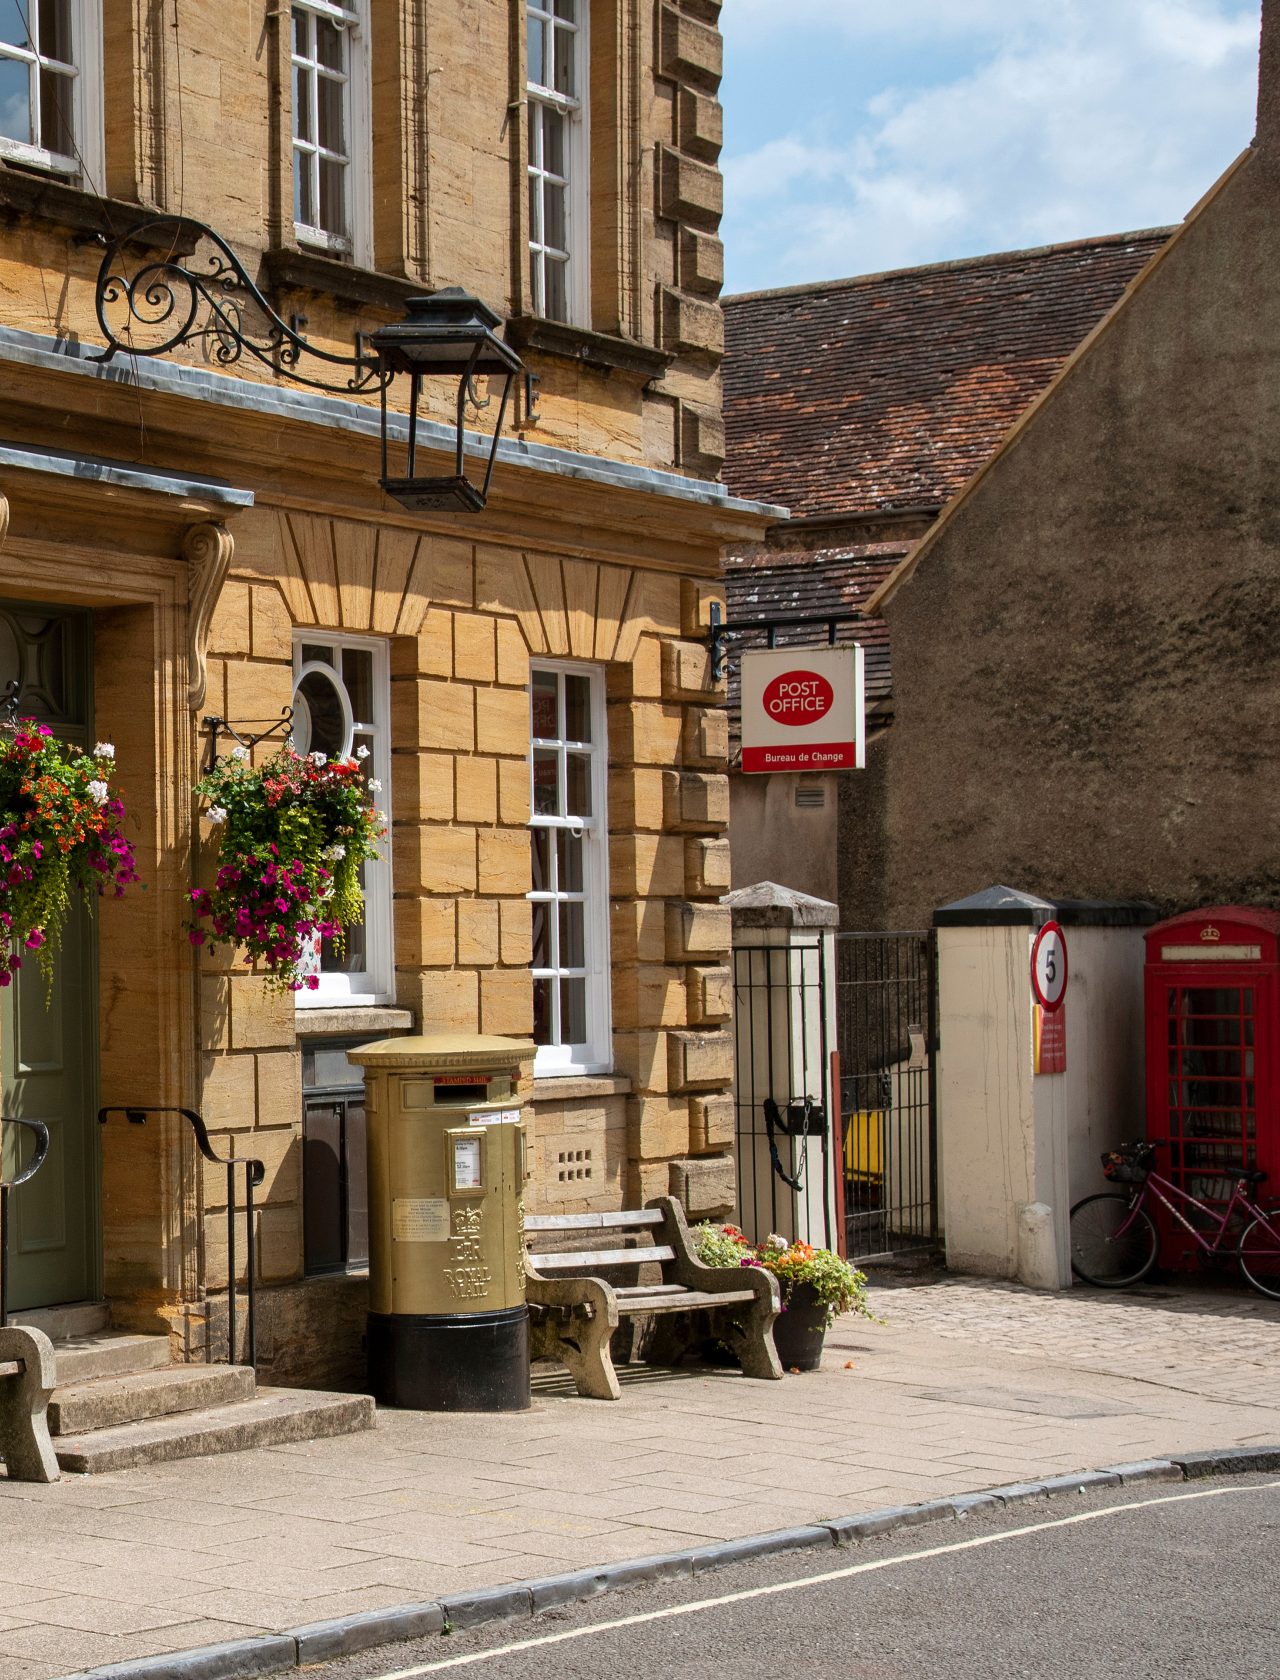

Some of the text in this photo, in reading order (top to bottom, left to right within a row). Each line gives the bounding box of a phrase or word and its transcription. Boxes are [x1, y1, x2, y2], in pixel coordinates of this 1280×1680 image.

[779, 681, 819, 697] POST
[769, 697, 825, 713] OFFICE
[765, 752, 844, 763] Bureau de Change
[1045, 949, 1057, 984] 5
